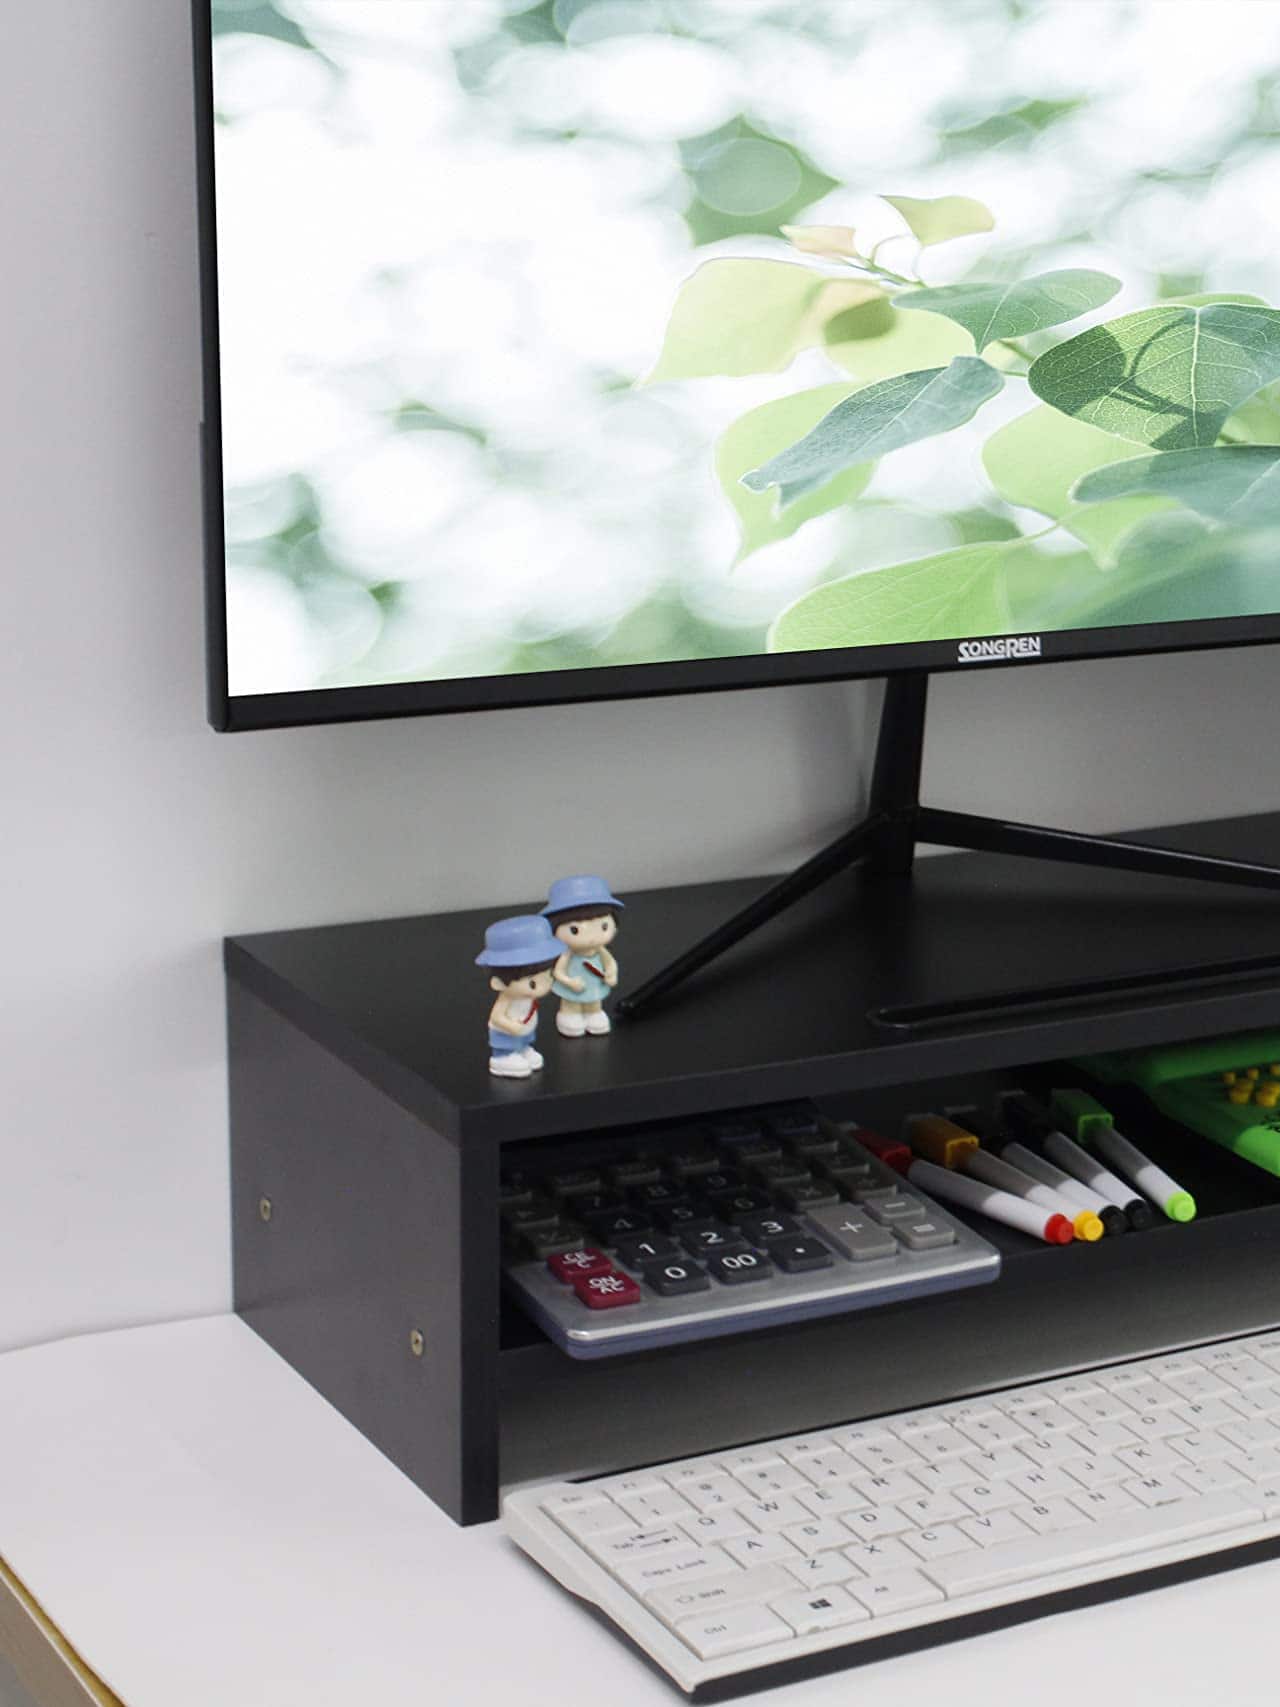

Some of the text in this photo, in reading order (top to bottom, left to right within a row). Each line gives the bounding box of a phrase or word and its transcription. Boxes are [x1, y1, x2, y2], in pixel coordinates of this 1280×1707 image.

[958, 636, 1041, 662] SONGREN
[761, 1220, 784, 1234] 3
[699, 1231, 725, 1245] 2
[638, 1242, 657, 1256] 1
[721, 1253, 757, 1269] 00
[664, 1266, 688, 1280] 0
[1140, 1415, 1158, 1425] O
[1033, 1439, 1052, 1449] U
[1183, 1438, 1200, 1447] L
[982, 1452, 997, 1462] Y
[1133, 1447, 1153, 1458] K
[925, 1464, 941, 1474] T
[1084, 1460, 1096, 1471] J
[871, 1476, 891, 1488] R
[1026, 1472, 1047, 1483] H
[1141, 1477, 1163, 1489] M
[815, 1490, 833, 1500] E
[973, 1486, 991, 1496] G
[1089, 1490, 1106, 1502] N
[757, 1501, 780, 1513] W
[916, 1500, 929, 1509] F
[1032, 1505, 1049, 1516] B
[697, 1517, 717, 1527] Q
[860, 1512, 878, 1523] D
[975, 1517, 993, 1528] V
[802, 1525, 819, 1536] S
[921, 1531, 938, 1542] C
[746, 1540, 763, 1549] A
[863, 1544, 881, 1554] X
[642, 1558, 706, 1577] Caps Lock
[806, 1559, 824, 1569] Z
[704, 1624, 728, 1635] Ctrl
